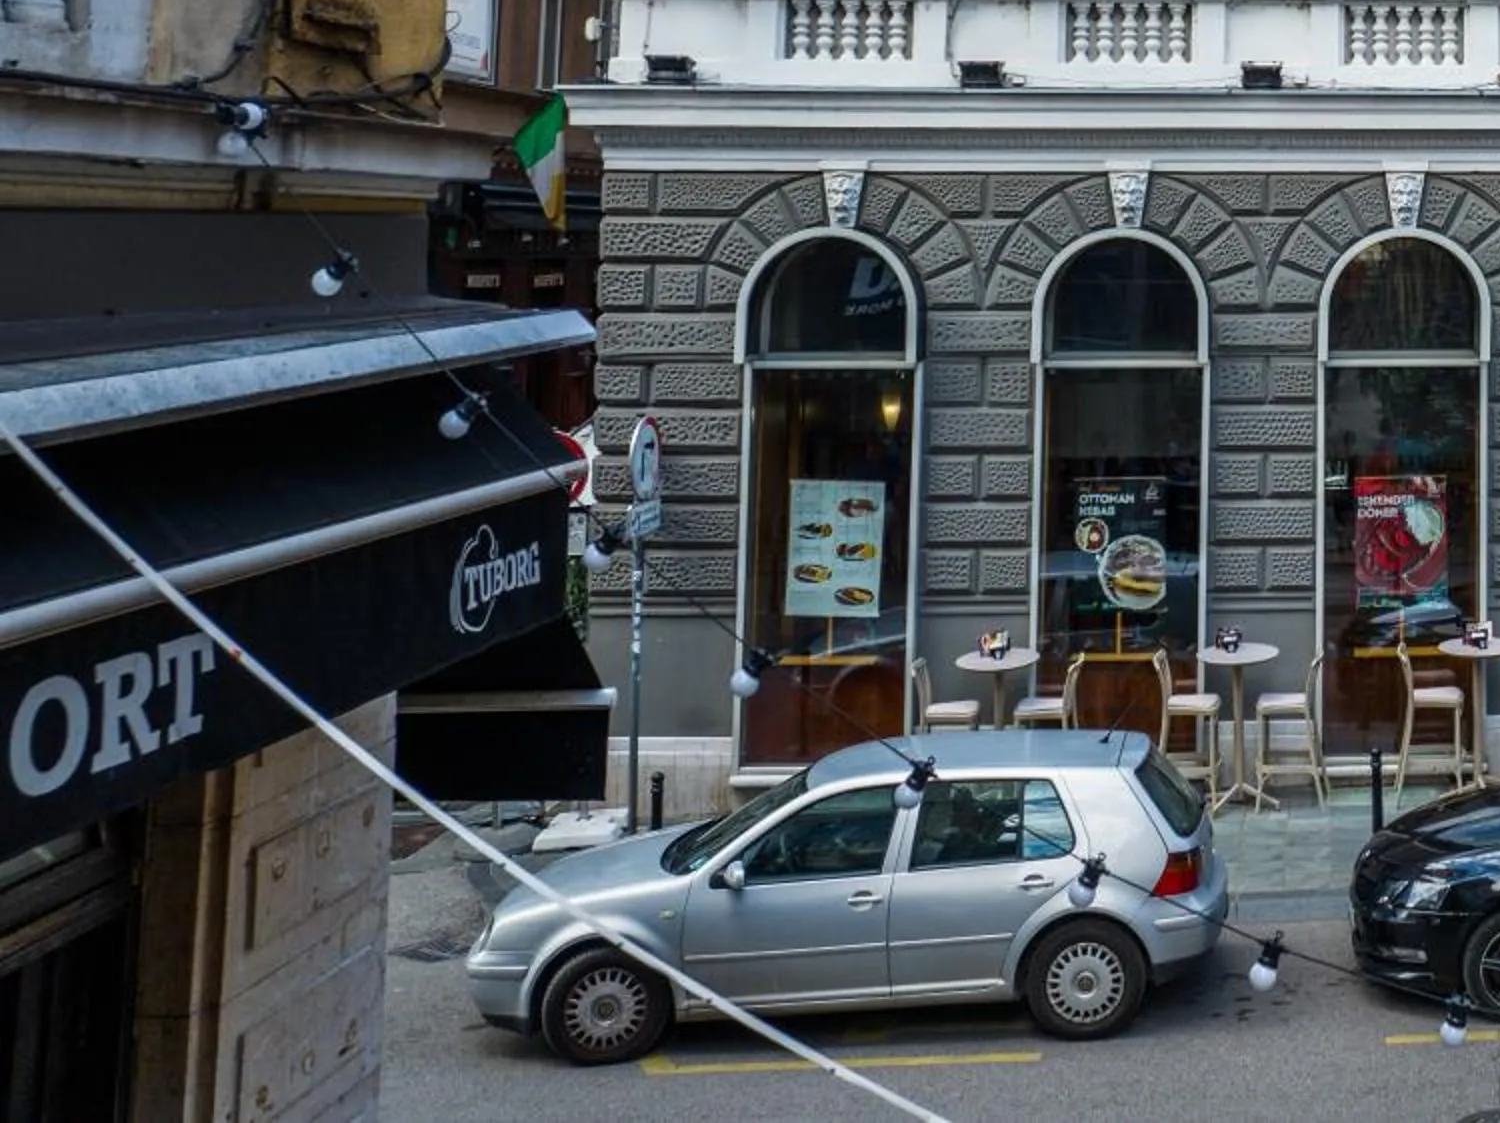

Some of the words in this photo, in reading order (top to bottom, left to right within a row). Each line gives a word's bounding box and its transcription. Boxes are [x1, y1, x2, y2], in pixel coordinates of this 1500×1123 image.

[1079, 492, 1135, 505] OTTOMAN
[464, 541, 541, 612] TUBORG
[9, 632, 216, 797] ORT
